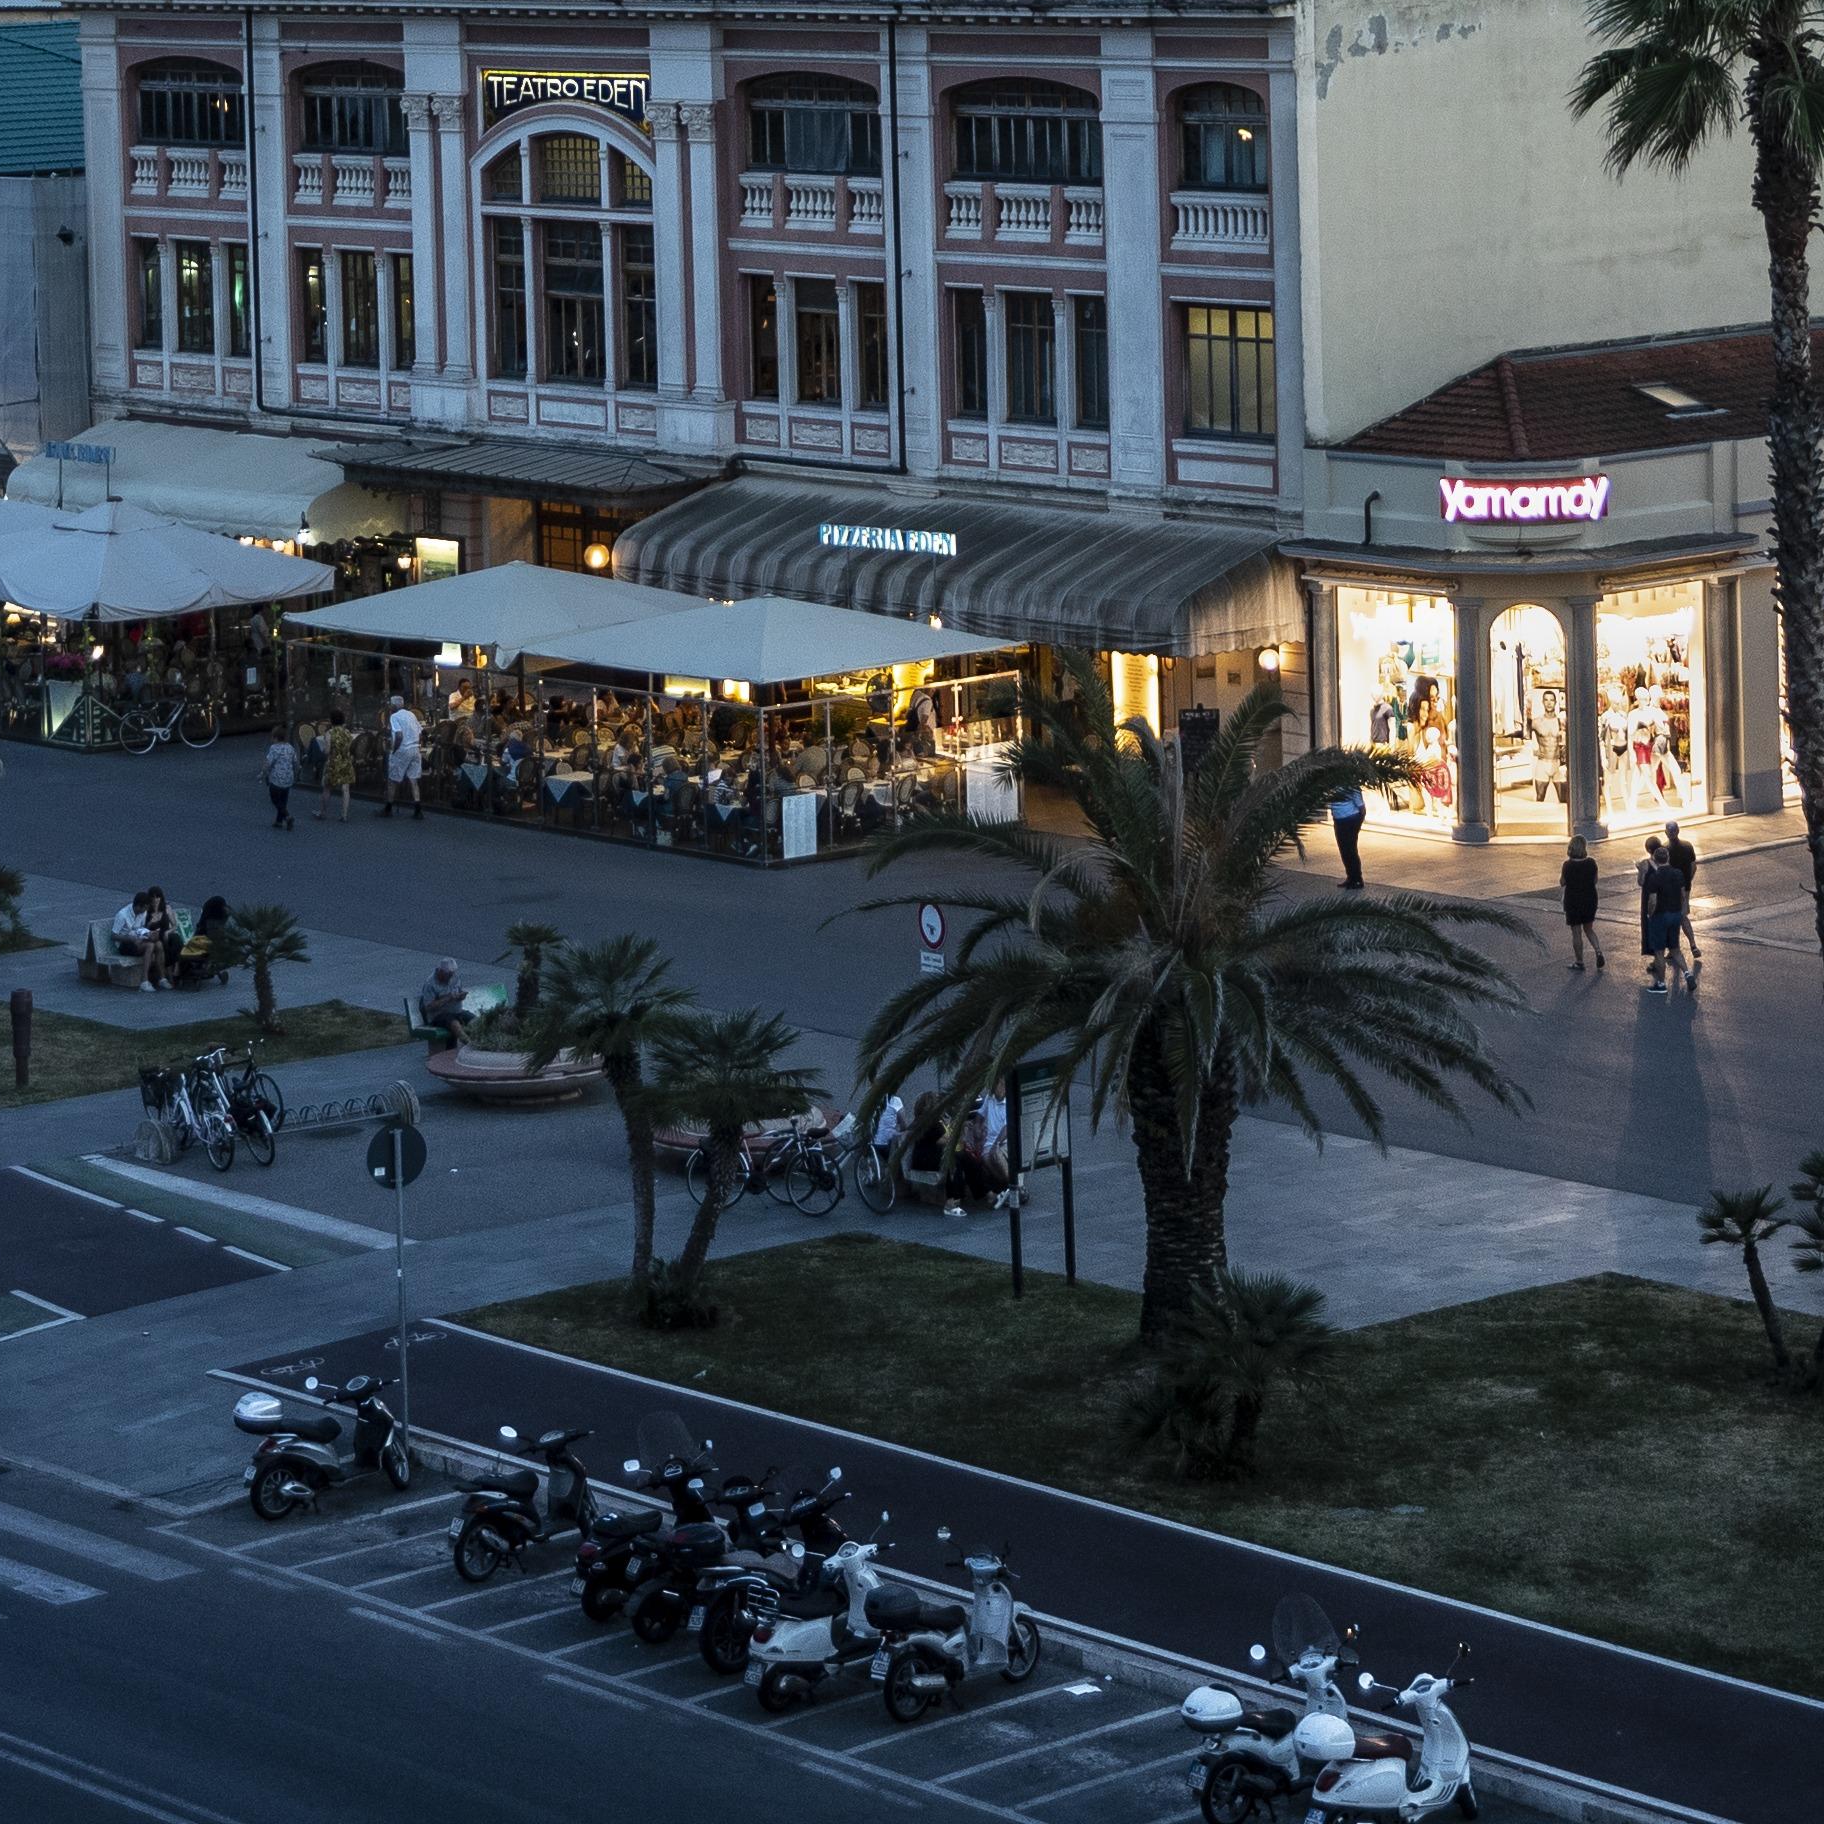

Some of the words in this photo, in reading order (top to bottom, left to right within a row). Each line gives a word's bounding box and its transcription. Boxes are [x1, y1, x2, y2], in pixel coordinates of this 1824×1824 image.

[487, 76, 579, 108] TEATRO
[583, 79, 646, 118] EDEN
[1439, 475, 1610, 523] Yamamay
[819, 523, 904, 551] PIZZERIA
[905, 530, 957, 556] EDEN
